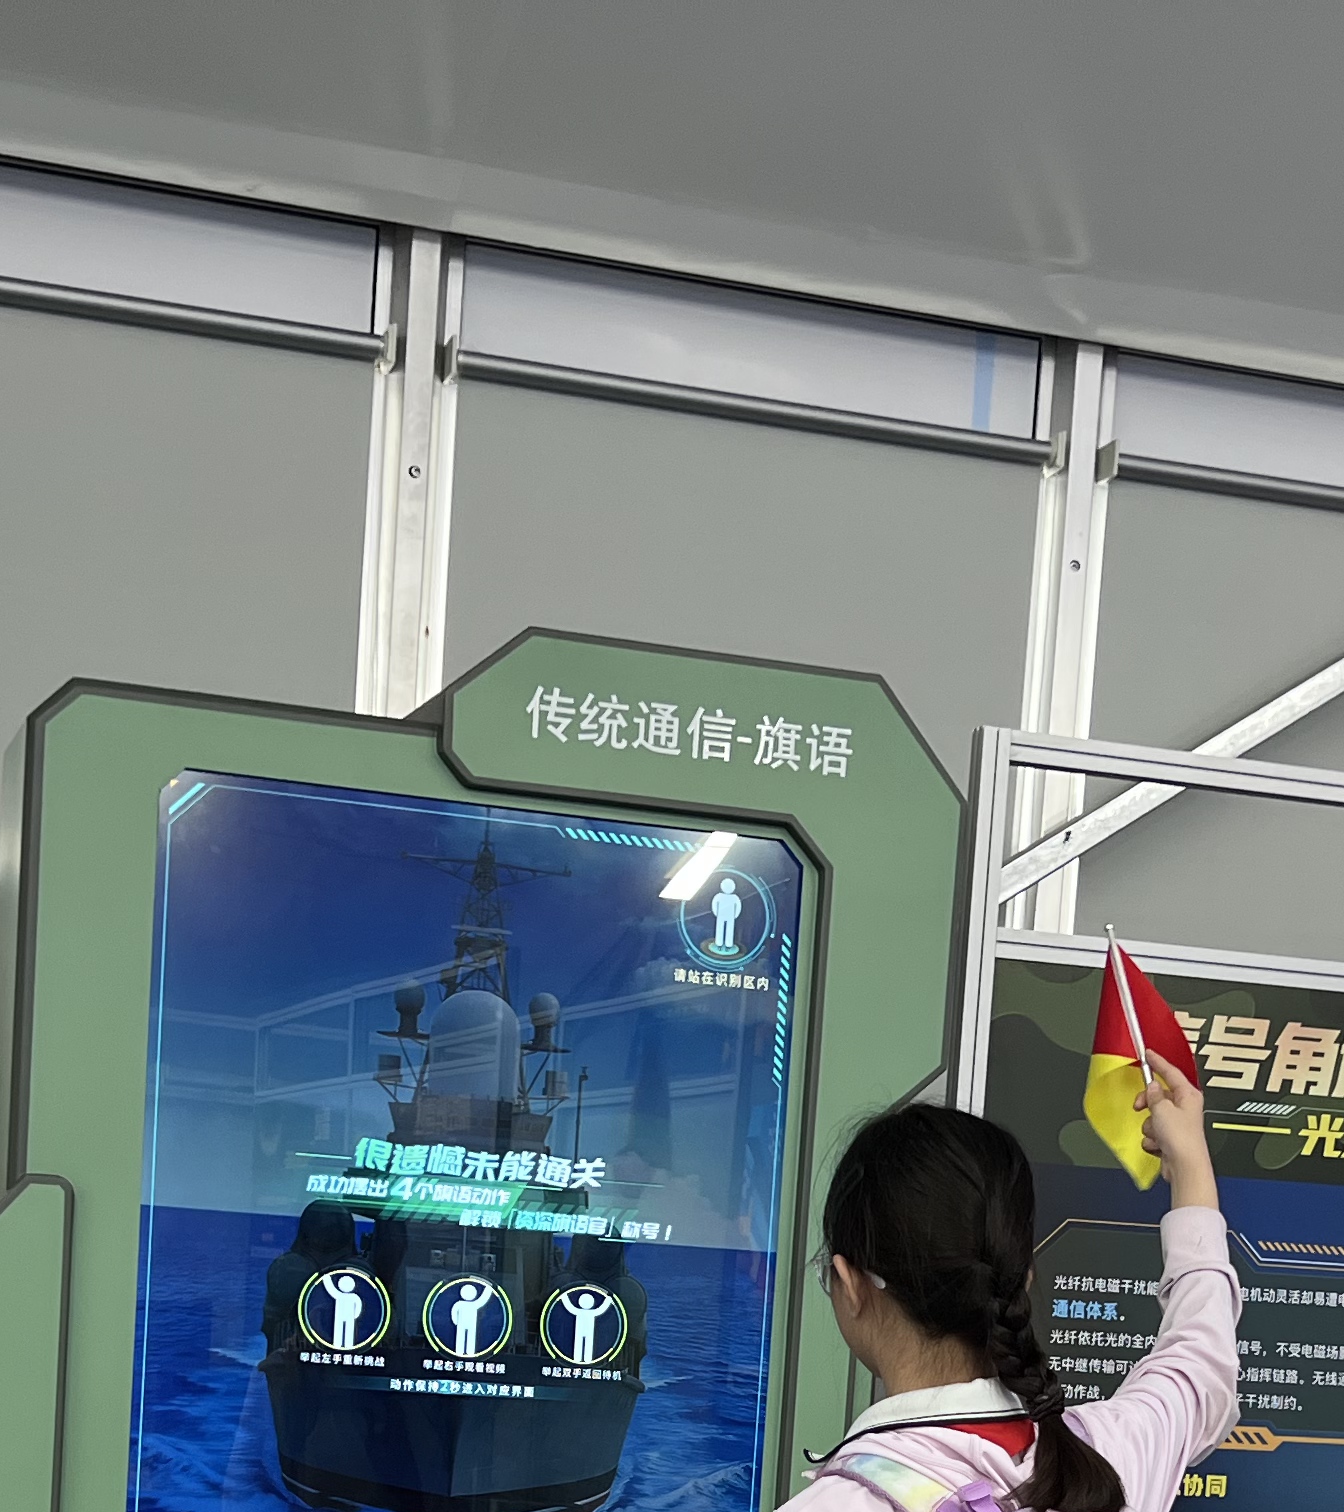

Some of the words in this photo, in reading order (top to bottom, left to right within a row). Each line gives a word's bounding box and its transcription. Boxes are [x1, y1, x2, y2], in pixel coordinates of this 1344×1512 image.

[525, 685, 854, 778] 传统通信-旗语
[674, 968, 769, 991] 请站在识别区内
[354, 1137, 607, 1189] 很遗憾未能通关
[1176, 1473, 1227, 1498] 协同
